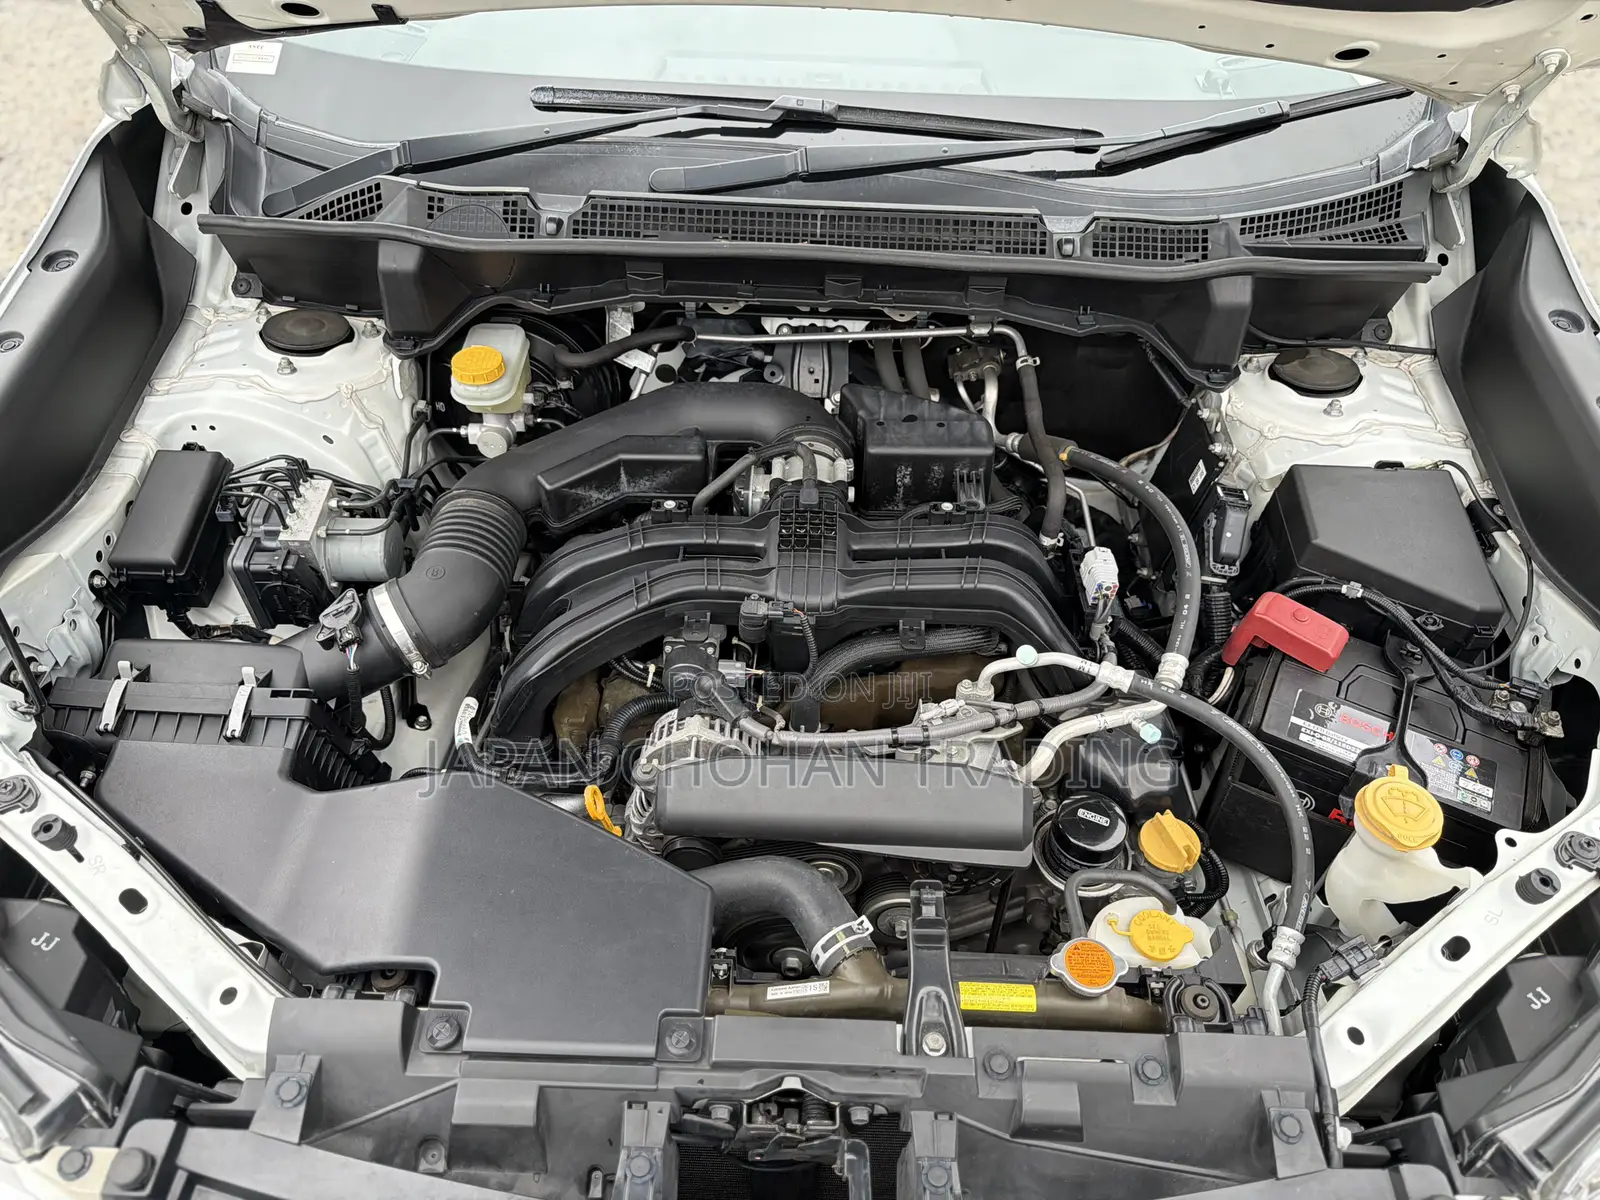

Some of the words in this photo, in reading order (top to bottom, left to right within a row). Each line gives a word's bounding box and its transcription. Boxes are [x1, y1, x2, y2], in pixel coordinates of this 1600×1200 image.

[1339, 713, 1395, 741] BOSCH
[31, 931, 60, 952] JJ
[1525, 986, 1551, 1010] JJ
